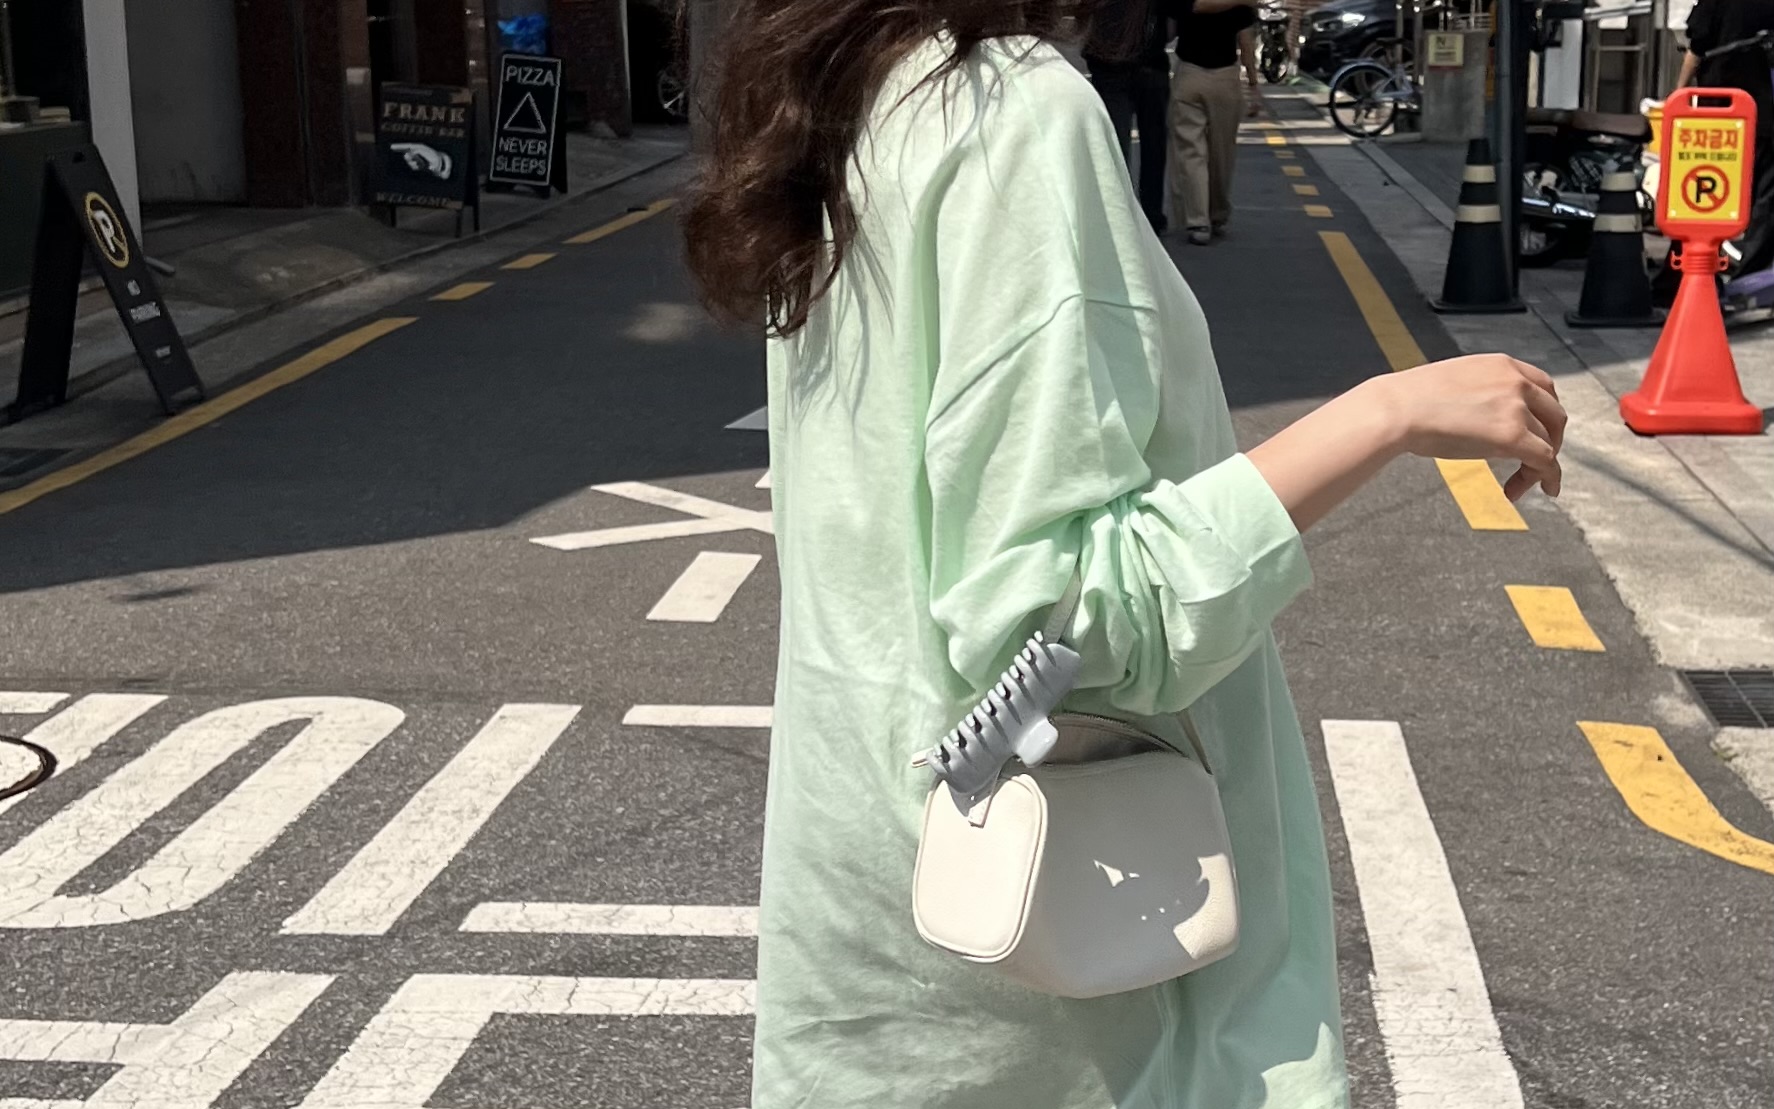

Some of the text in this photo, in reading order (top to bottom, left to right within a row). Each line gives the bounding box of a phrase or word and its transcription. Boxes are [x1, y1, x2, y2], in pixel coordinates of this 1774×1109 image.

[505, 65, 555, 87] PIZZA
[383, 102, 465, 123] FRANK
[498, 136, 548, 156] NEVER
[1679, 129, 1738, 149] 주차금지
[496, 155, 547, 176] SLEEPS
[1696, 176, 1717, 203] P
